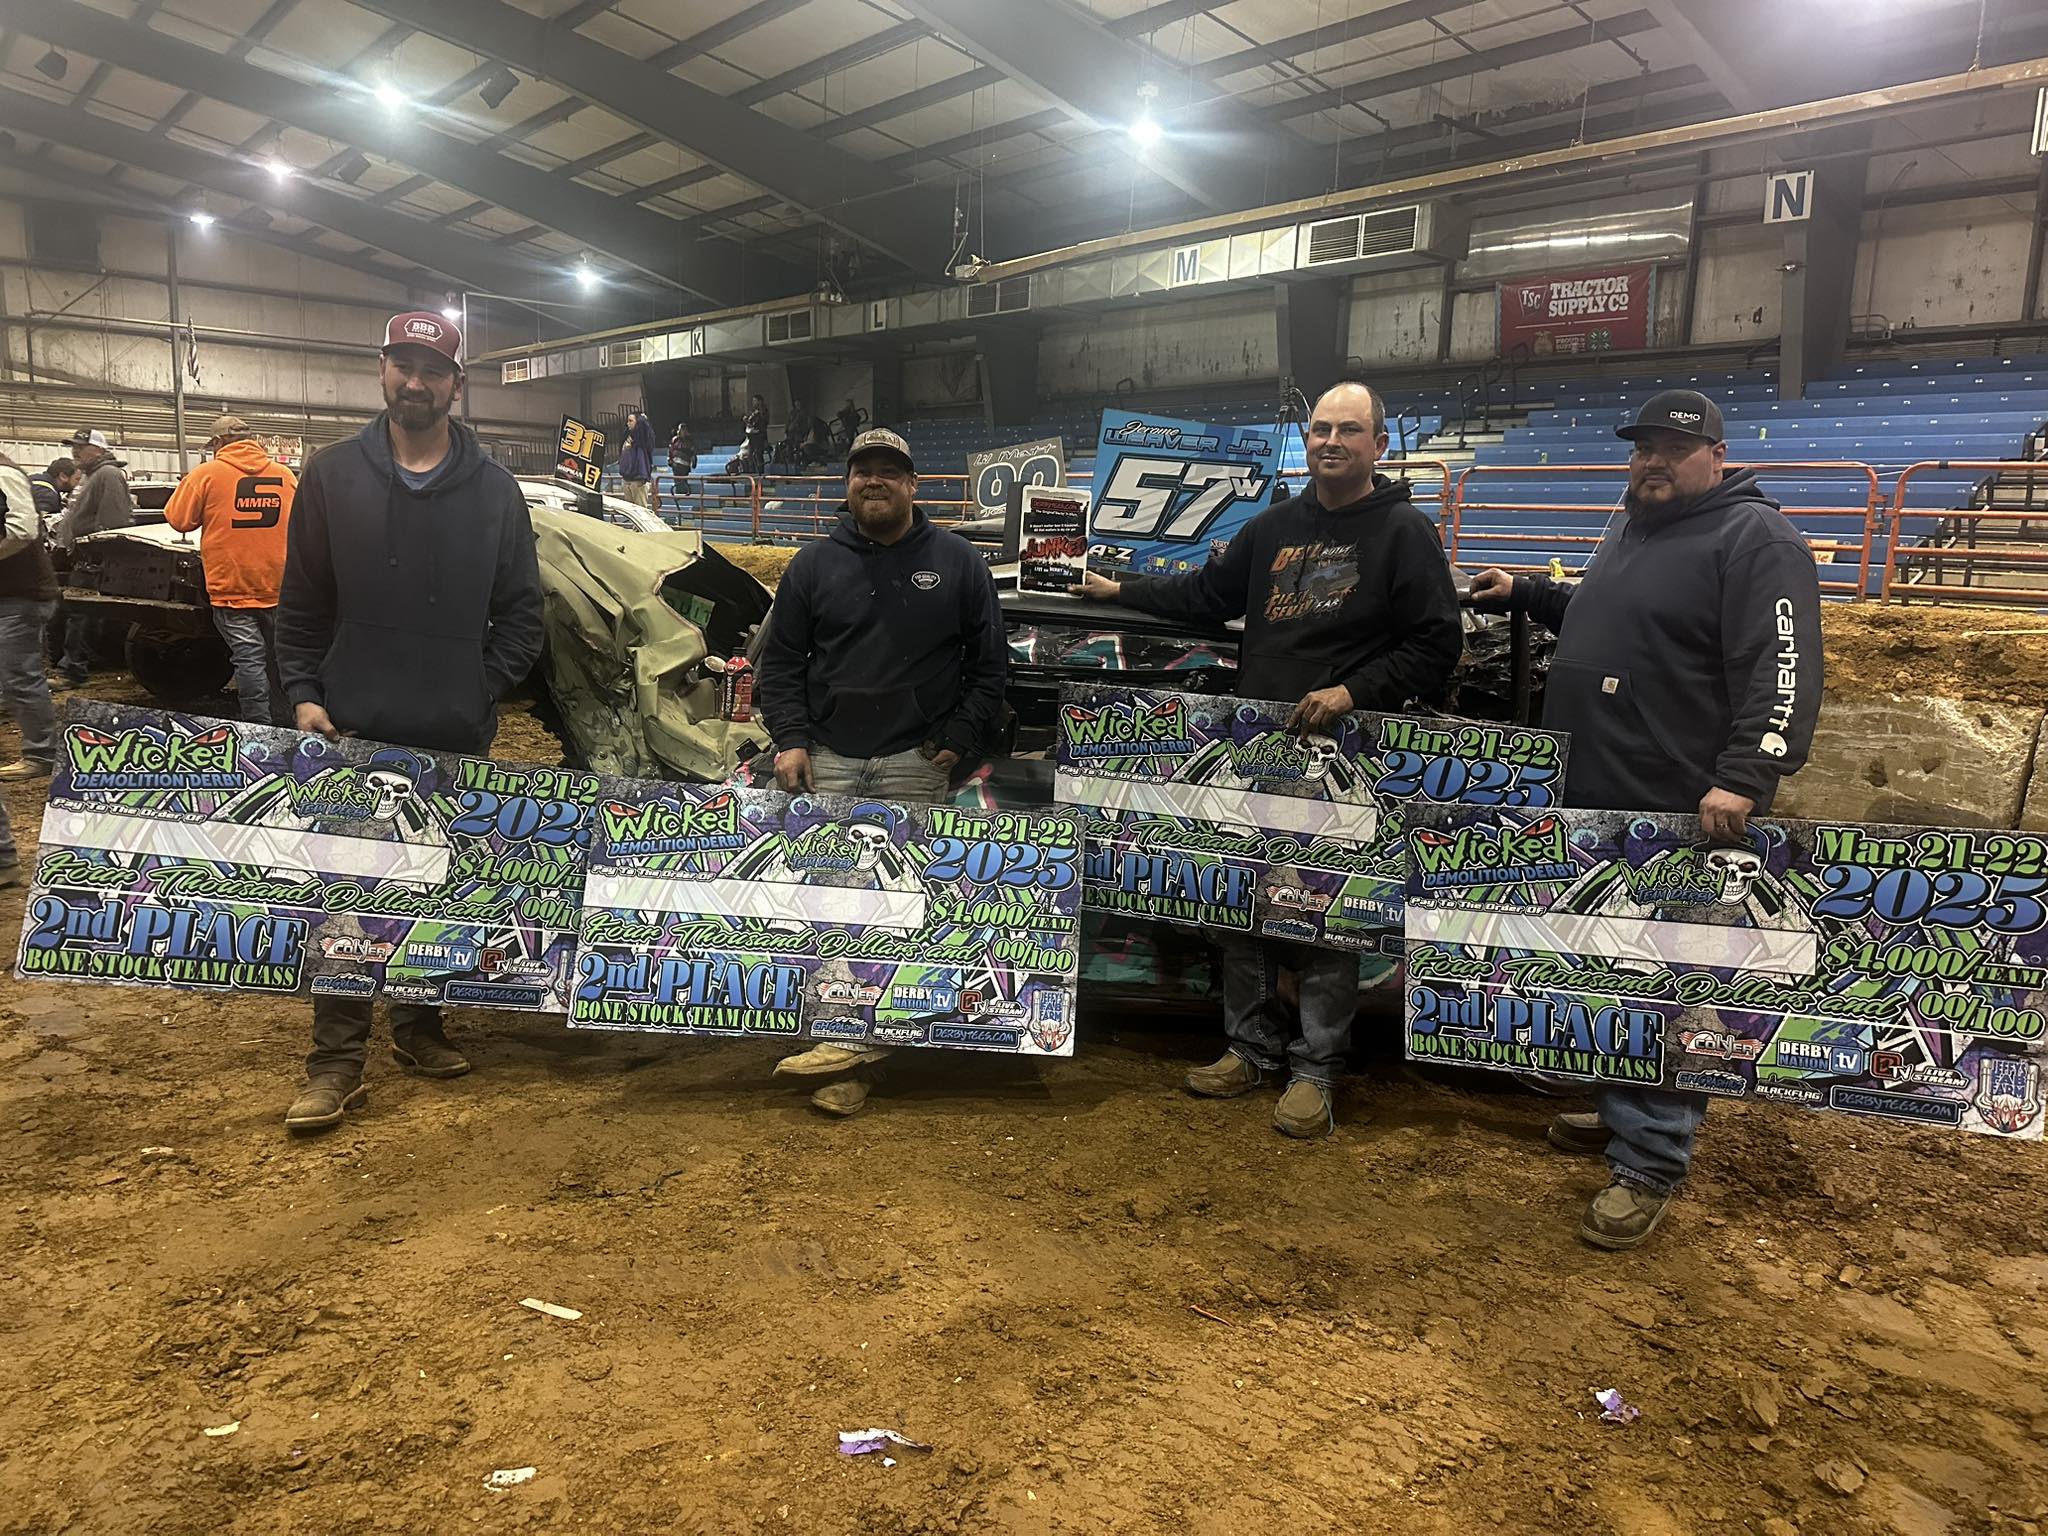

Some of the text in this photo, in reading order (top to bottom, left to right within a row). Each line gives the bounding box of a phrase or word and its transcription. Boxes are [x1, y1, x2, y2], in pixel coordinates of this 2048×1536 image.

[1773, 177, 1807, 219] N
[1176, 249, 1198, 281] M
[1521, 289, 1542, 310] TSC
[1550, 276, 1629, 300] TRACTOR
[874, 305, 883, 328] L
[1548, 296, 1609, 317] SUPPLY
[412, 321, 435, 333] BBB
[694, 332, 702, 354] K
[601, 347, 606, 366] J
[1120, 420, 1180, 436] Jerome
[1669, 411, 1701, 421] DEMO
[1104, 428, 1272, 455] WEAVER JR.
[237, 497, 280, 508] MMRS
[1769, 597, 1799, 732] carhartt
[1064, 698, 1186, 745] Wicked
[1072, 739, 1193, 757] DEMOLITION DERBY
[1381, 719, 1451, 754] Mar.
[67, 726, 237, 774] Wicked
[75, 771, 244, 789] DEMOLITION DERBY
[457, 760, 599, 804] Mar. 21-2
[1374, 750, 1556, 807] 2025
[602, 794, 738, 842] Wicked
[928, 810, 989, 839] Mar.
[609, 833, 745, 857] DEMOLITION DERBY
[1129, 820, 1374, 871] Thousand Dollars
[1414, 817, 1566, 872] Wicked
[1818, 829, 1906, 866] Mar.
[455, 853, 585, 889] $4,000/TE
[591, 865, 616, 877] Pay
[618, 867, 636, 878] To
[637, 868, 661, 880] The
[662, 870, 695, 882] Order
[923, 838, 1076, 889] 2025
[1426, 862, 1578, 888] DEMOLITION DERBY
[39, 851, 580, 929] Four Thousand Dollars and 00/1
[1122, 851, 1250, 909] PLACE
[1099, 888, 1150, 913] STOCK
[1152, 896, 1197, 919] TEAM
[1199, 903, 1249, 928] CLASS
[1343, 896, 1384, 912] DERBY
[1410, 896, 1438, 908] Pay
[1439, 898, 1456, 909] To
[1458, 900, 1482, 912] The
[1485, 902, 1523, 914] Order
[1670, 888, 1716, 904] DERBY
[1812, 863, 2048, 930] 2025
[930, 896, 1074, 931] $4,000/TEAM
[1343, 907, 1381, 922] NATION
[29, 896, 306, 966] 2nd PLACE
[584, 913, 1074, 971] Four Thousand Dollars and 00/100
[1324, 933, 1374, 947] BLACKFLAG
[333, 938, 388, 962] COLYER
[406, 954, 447, 967] NATION
[408, 943, 450, 956] DERBY
[1824, 936, 2045, 985] $4,000/TEAM
[25, 949, 296, 986] BONE STOCK TEAM CLASS
[384, 983, 438, 996] BLACKFLAG
[577, 954, 801, 1010] 2nd PLACE
[894, 986, 932, 1000] DERBY
[1410, 945, 2044, 1038] Four Thousand Dollars and 00/100
[829, 984, 875, 1005] COLYER
[893, 999, 929, 1010] NATION
[575, 1000, 796, 1030] BONE STOCK TEAM CLASS
[1040, 1010, 1063, 1022] FARM
[1411, 989, 1659, 1057] 2nd PLACE
[875, 1027, 923, 1037] BLACKFLAG
[1412, 1033, 1657, 1081] BONE STOCK TEAM CLASS
[1694, 1033, 1754, 1059] COLYER
[1779, 1041, 1829, 1059] DERBY
[1779, 1055, 1829, 1071] NATION
[1926, 1068, 1954, 1078] LIVE
[1912, 1074, 1967, 1087] STREAM
[1992, 1084, 2026, 1099] FARM
[1755, 1085, 1820, 1101] BLACKFLAG
